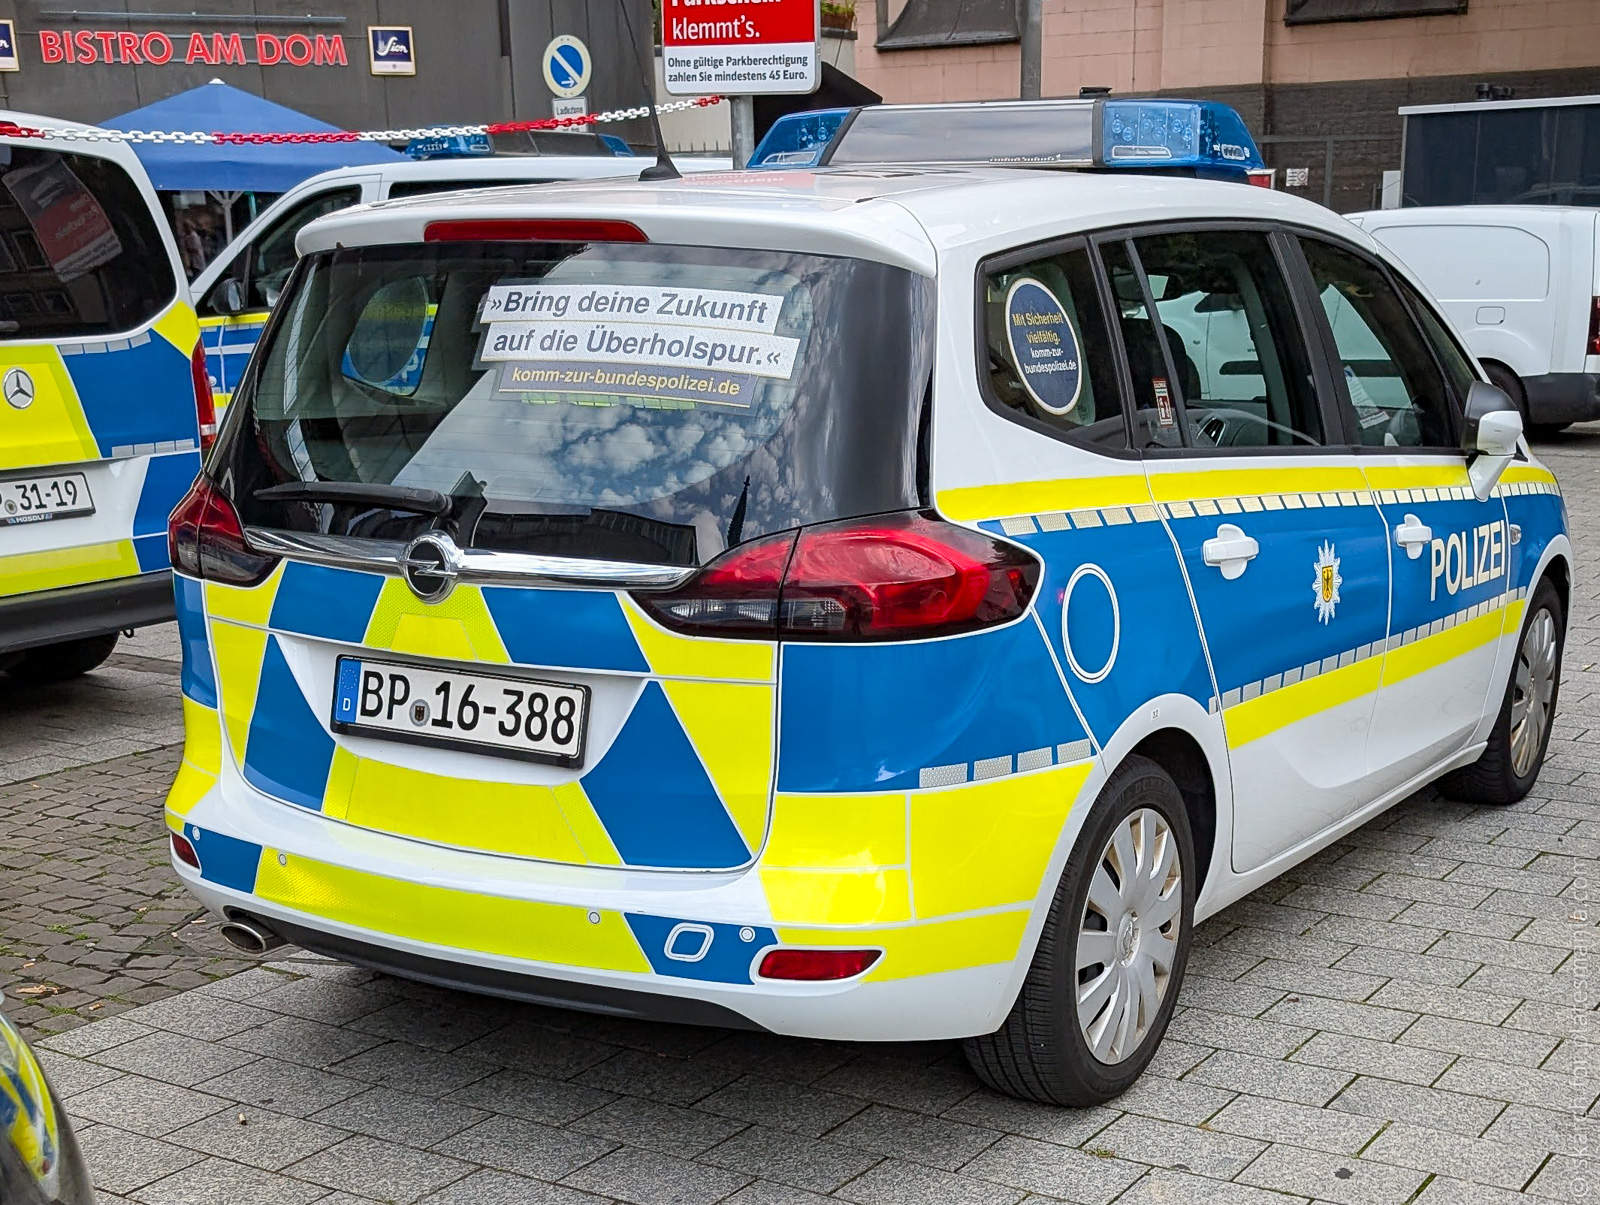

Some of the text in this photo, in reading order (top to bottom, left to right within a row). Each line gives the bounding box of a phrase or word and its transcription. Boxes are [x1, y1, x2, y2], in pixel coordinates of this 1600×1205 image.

[672, 15, 761, 40] klemmt’s.
[39, 30, 349, 67] BISTRO AM DOM
[376, 36, 409, 57] Sion
[668, 54, 808, 69] Ohne gültige Parkberechtigung
[668, 70, 807, 82] zahlen Sie mindestens 45 Euro.
[490, 290, 768, 323] »Bring deine Zukunft
[1012, 311, 1064, 326] Mit Sicherheit
[493, 324, 781, 366] auf die Überholspur.«
[1026, 329, 1061, 345] vielfältig.
[511, 366, 741, 396] komm-zur-bundespolizei.de
[1431, 519, 1505, 602] POLIZEI
[342, 697, 351, 712] D
[360, 669, 577, 746] BP 16-388
